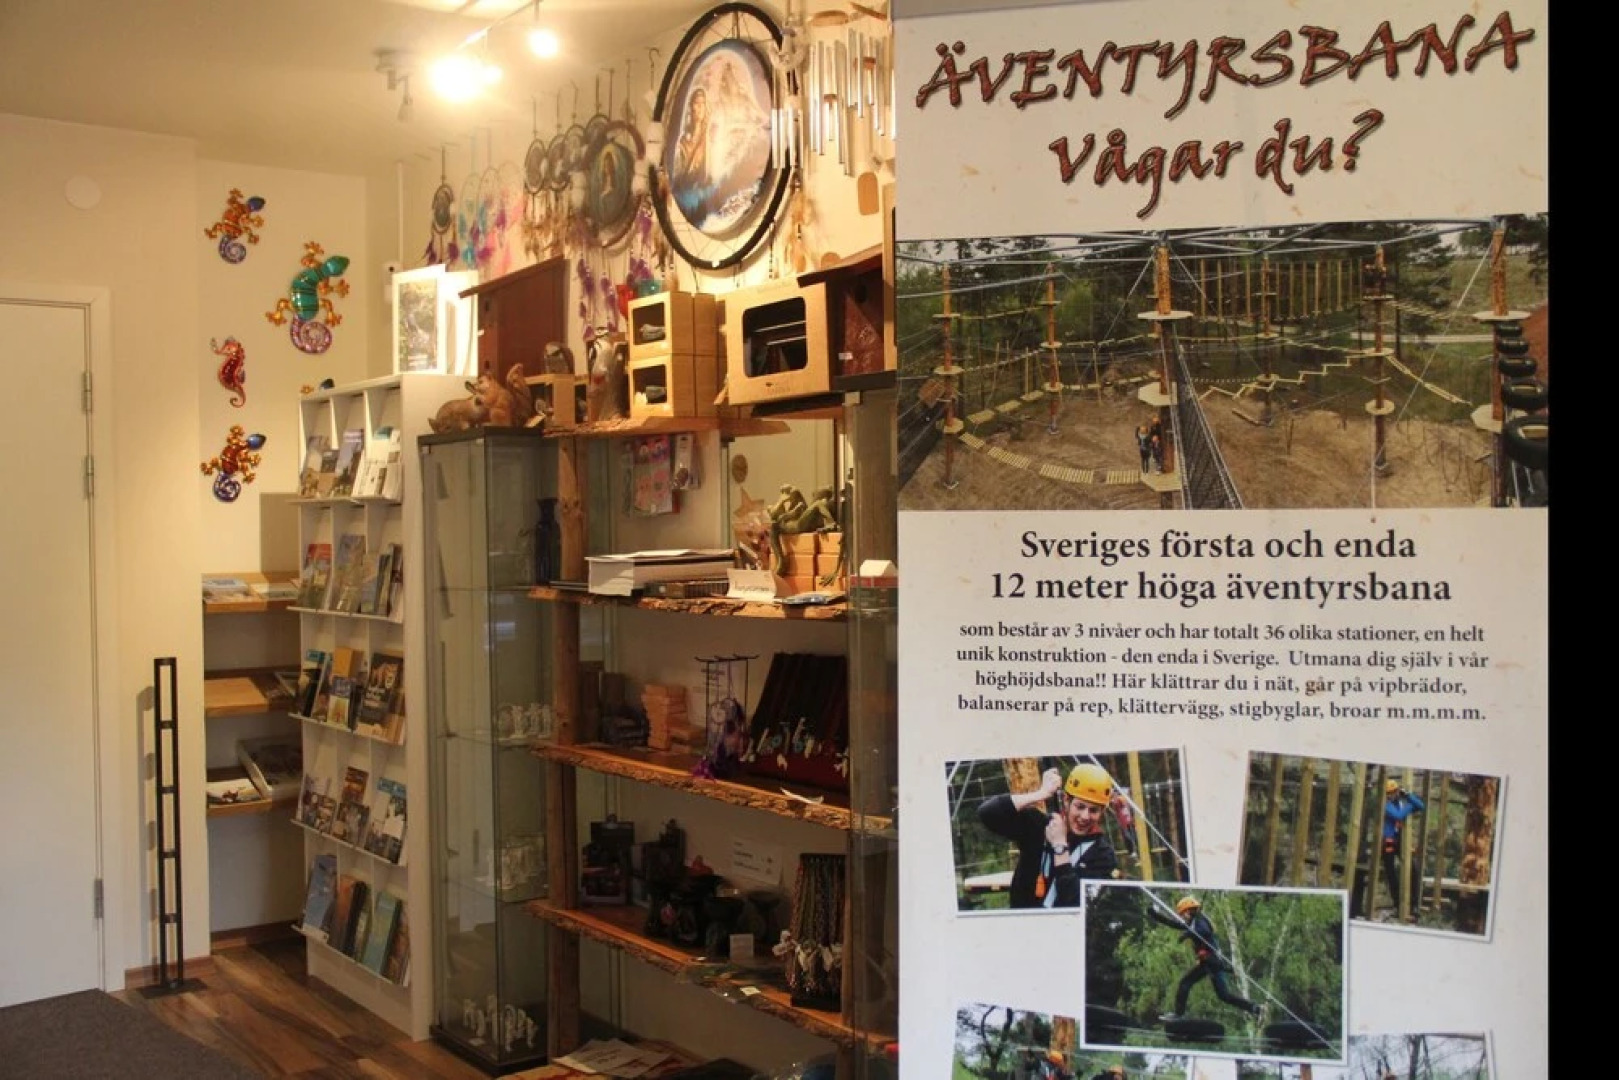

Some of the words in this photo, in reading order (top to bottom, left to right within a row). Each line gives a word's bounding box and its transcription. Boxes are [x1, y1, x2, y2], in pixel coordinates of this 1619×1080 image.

[915, 11, 1535, 119] ÄVENTYRSBANA
[1048, 127, 1243, 218] Vågar
[1255, 109, 1384, 195] du?
[1021, 529, 1150, 567] Sveriges
[1161, 529, 1255, 558] första
[1265, 529, 1324, 558] och
[1334, 529, 1417, 558] enda
[990, 573, 1025, 598] 12
[1036, 576, 1129, 599] meter
[1138, 571, 1216, 608] höga
[1227, 571, 1451, 609] äventyrsbana
[959, 626, 994, 637] som
[998, 621, 1048, 638] består
[1051, 627, 1070, 638] av
[1074, 623, 1084, 638] 3
[1089, 622, 1141, 638] nivåer
[1145, 623, 1175, 638] och
[1179, 623, 1209, 639] har
[1213, 624, 1259, 639] totalt
[1263, 625, 1285, 640] 36
[1289, 625, 1332, 640] olika
[1336, 625, 1420, 643] stationer,
[1424, 630, 1446, 641] en
[1450, 625, 1485, 641] helt
[956, 646, 994, 662] unik
[998, 646, 1107, 663] konstruktion
[1121, 648, 1153, 663] den
[1157, 648, 1199, 664] enda
[1202, 648, 1209, 664] i
[1213, 650, 1280, 670] Sverige.
[1289, 651, 1362, 666] Utmana
[1367, 651, 1397, 672] dig
[1401, 651, 1443, 672] själv
[1448, 651, 1454, 667] i
[1458, 651, 1489, 667] vår
[975, 670, 1107, 690] höghöjdsbana!!
[1112, 673, 1147, 689] Här
[1151, 673, 1219, 690] klättrar
[1225, 675, 1248, 690] du
[1253, 675, 1259, 691] i
[1265, 677, 1300, 695] nät,
[1305, 677, 1335, 696] går
[1340, 677, 1362, 697] på
[1368, 677, 1468, 698] vipbrädor,
[958, 694, 1049, 712] balanserar
[1053, 698, 1075, 716] på
[1080, 703, 1113, 717] rep,
[1118, 698, 1225, 719] klättervägg,
[1229, 701, 1324, 722] stigbyglar,
[1330, 701, 1381, 718] broar
[1387, 706, 1487, 719] m.m.m.m.
